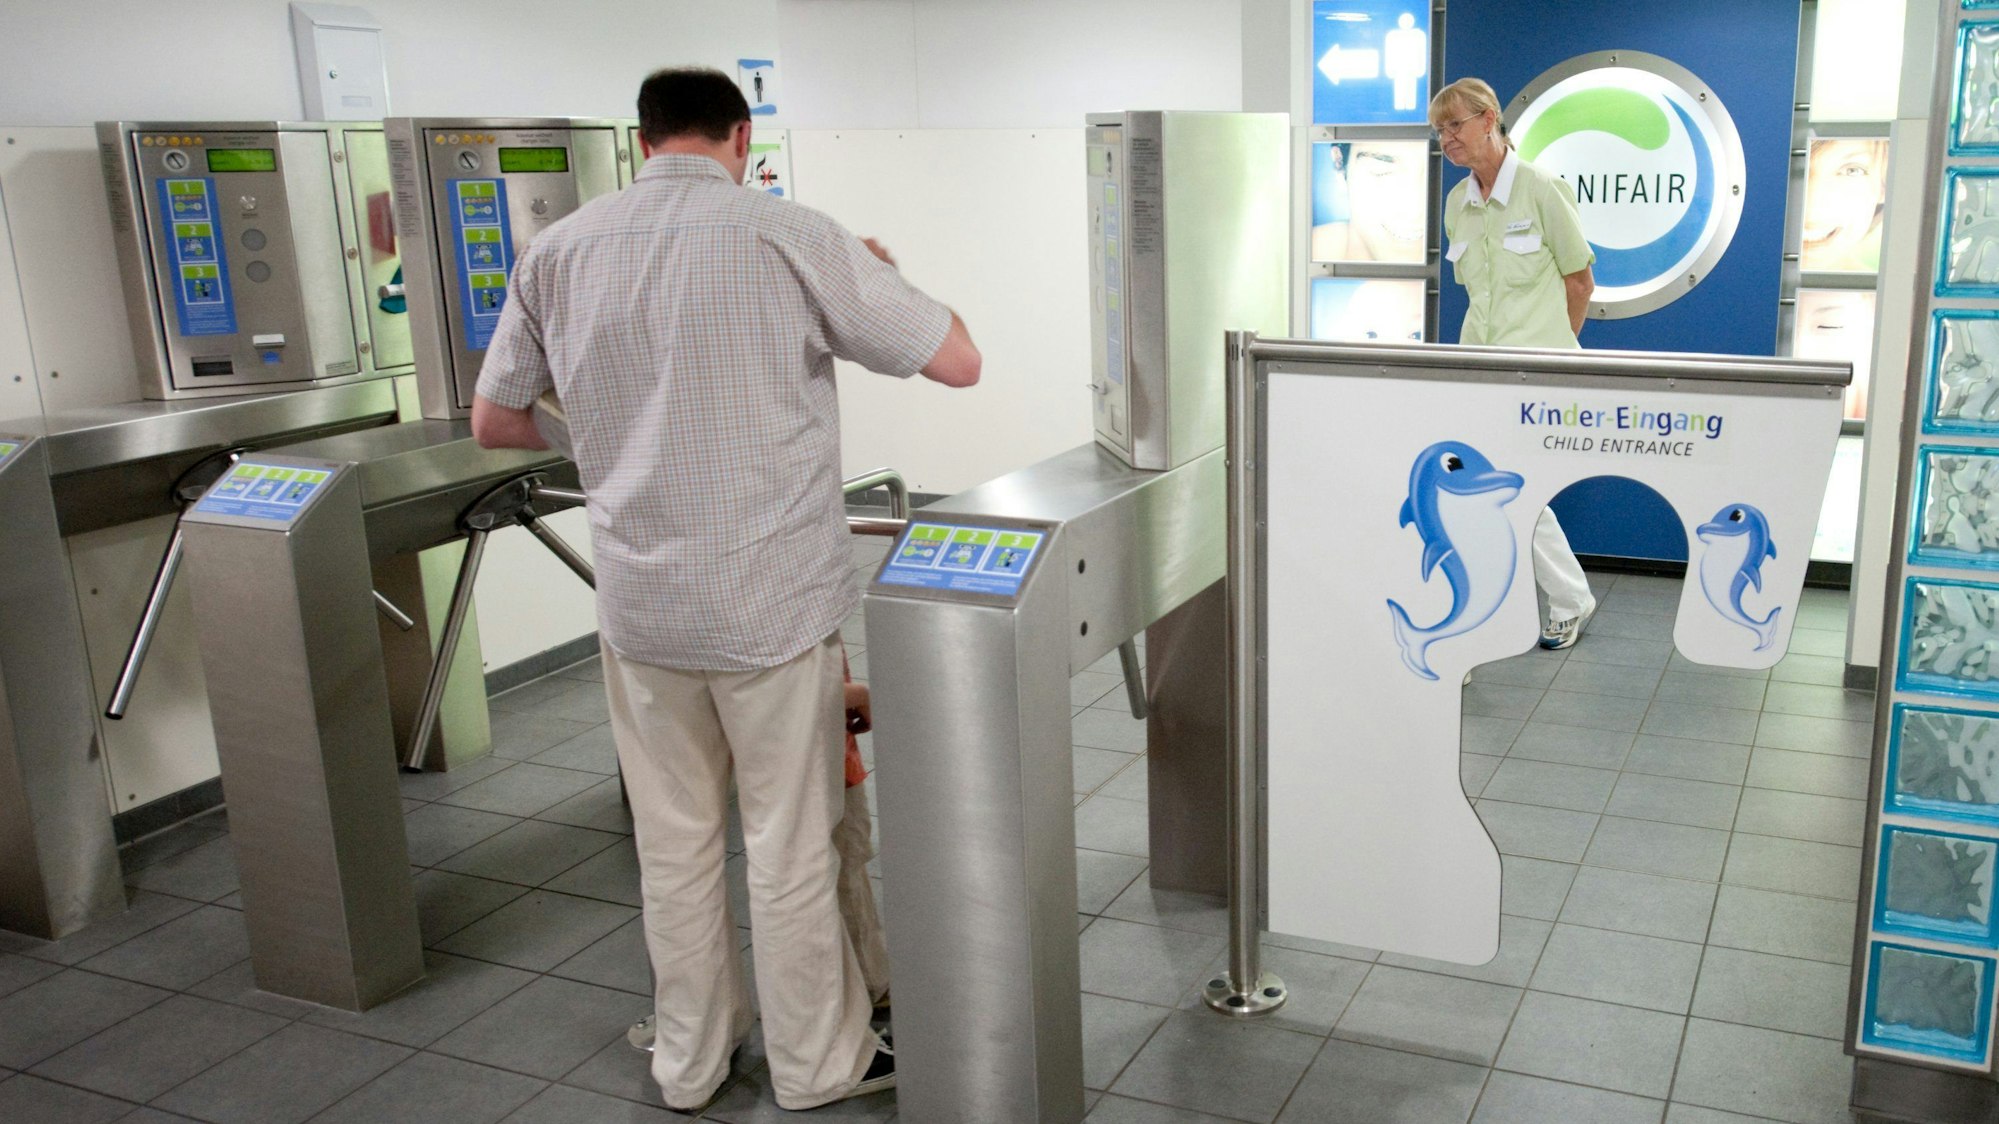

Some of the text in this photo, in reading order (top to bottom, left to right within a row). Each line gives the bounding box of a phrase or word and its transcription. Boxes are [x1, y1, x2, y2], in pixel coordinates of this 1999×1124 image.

[474, 184, 481, 195] 1
[1561, 173, 1686, 204] NIFAIR
[190, 225, 197, 235] 2
[479, 230, 487, 241] 2
[197, 267, 204, 277] 3
[484, 275, 492, 286] 3
[1520, 402, 1723, 439] Kinder-Eingang
[1543, 435, 1694, 456] CHILD ENTRANCE
[927, 528, 1022, 546] 1 2 3
